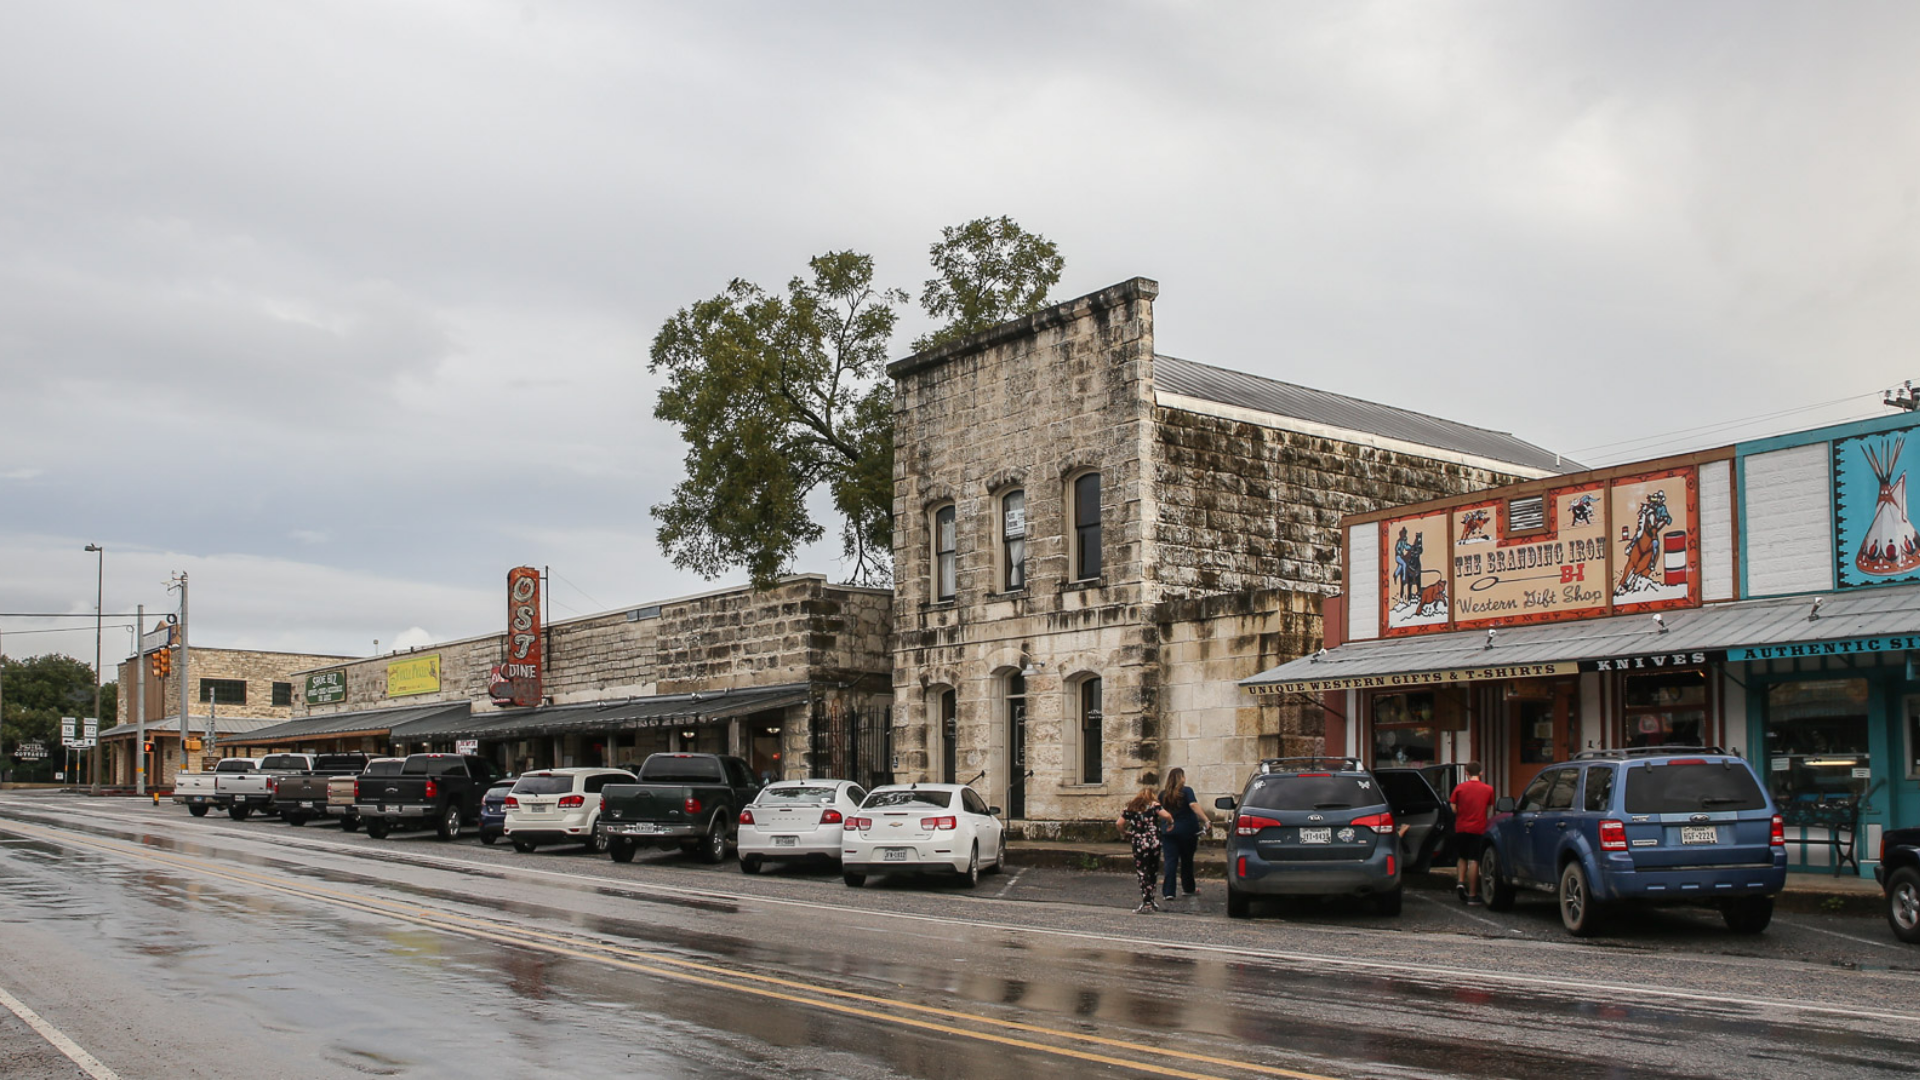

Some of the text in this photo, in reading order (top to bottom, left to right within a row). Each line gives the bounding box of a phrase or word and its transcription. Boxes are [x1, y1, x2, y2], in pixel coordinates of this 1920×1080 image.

[1454, 536, 1606, 577] THE BRANDING IRON
[1456, 584, 1603, 614] Western Gift Shop
[1596, 652, 1706, 671] KNIVES
[1744, 637, 1920, 660] AUTHENTIC SI
[509, 664, 537, 679] DINE
[1248, 664, 1556, 695] UNIQUE WESTERN GIFTS & T-SHIRTS
